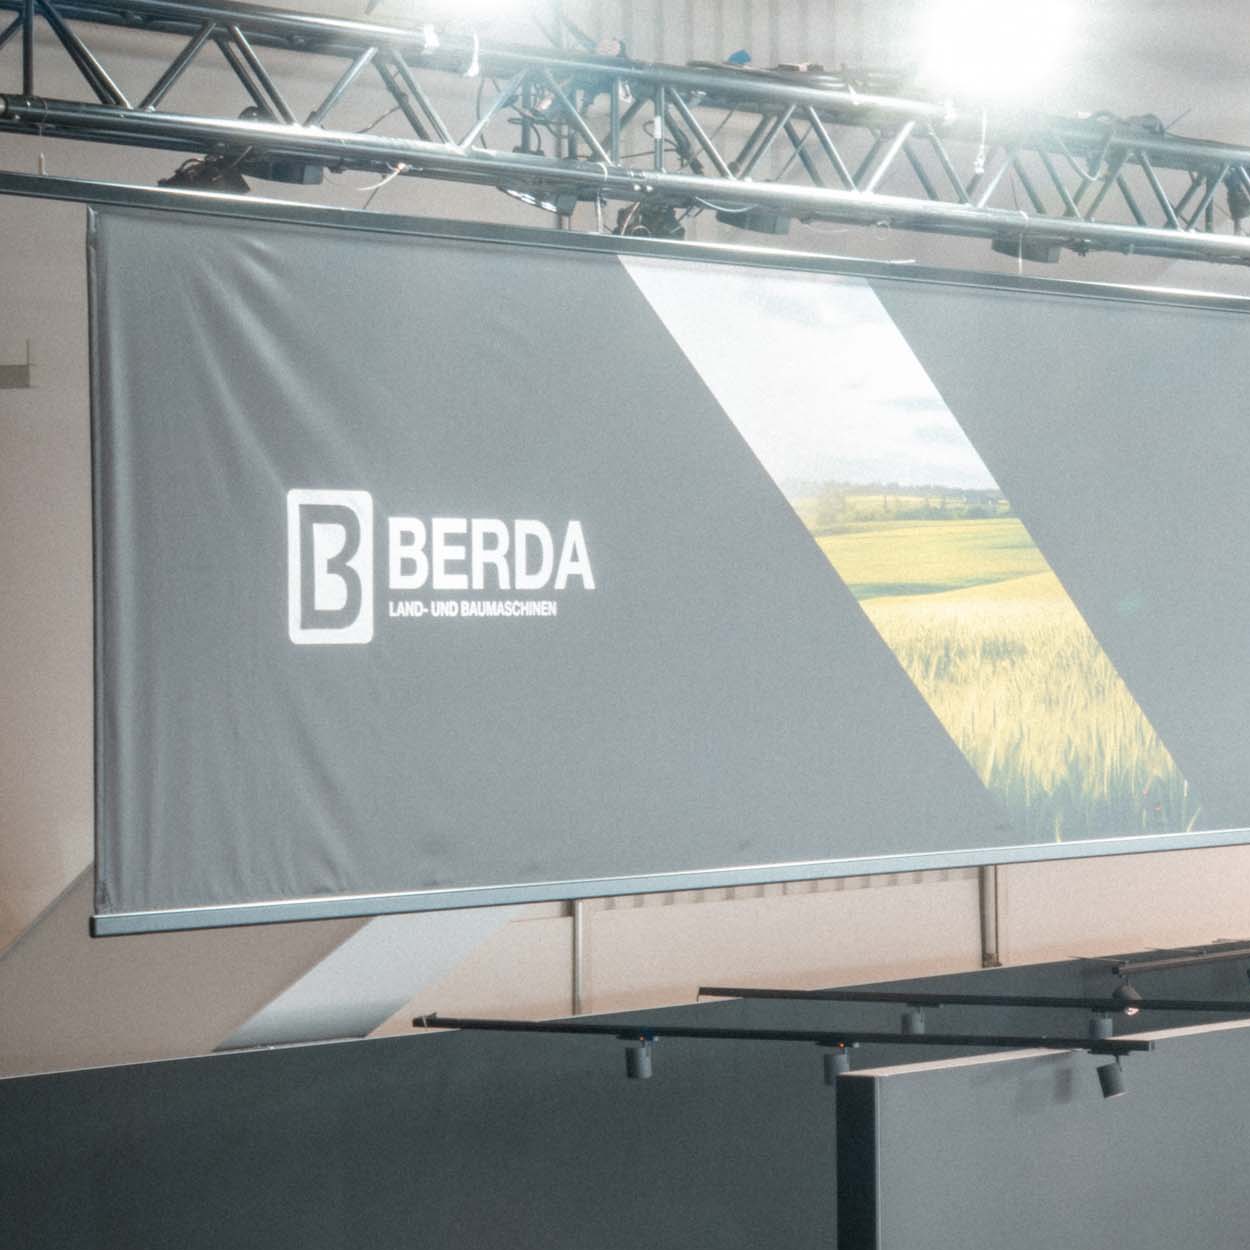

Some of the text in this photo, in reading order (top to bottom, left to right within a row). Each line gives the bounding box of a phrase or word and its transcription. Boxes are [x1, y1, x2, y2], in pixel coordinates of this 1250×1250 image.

[387, 516, 596, 590] BERDA
[388, 600, 558, 618] LAND- UND BAUMASCHINEN
